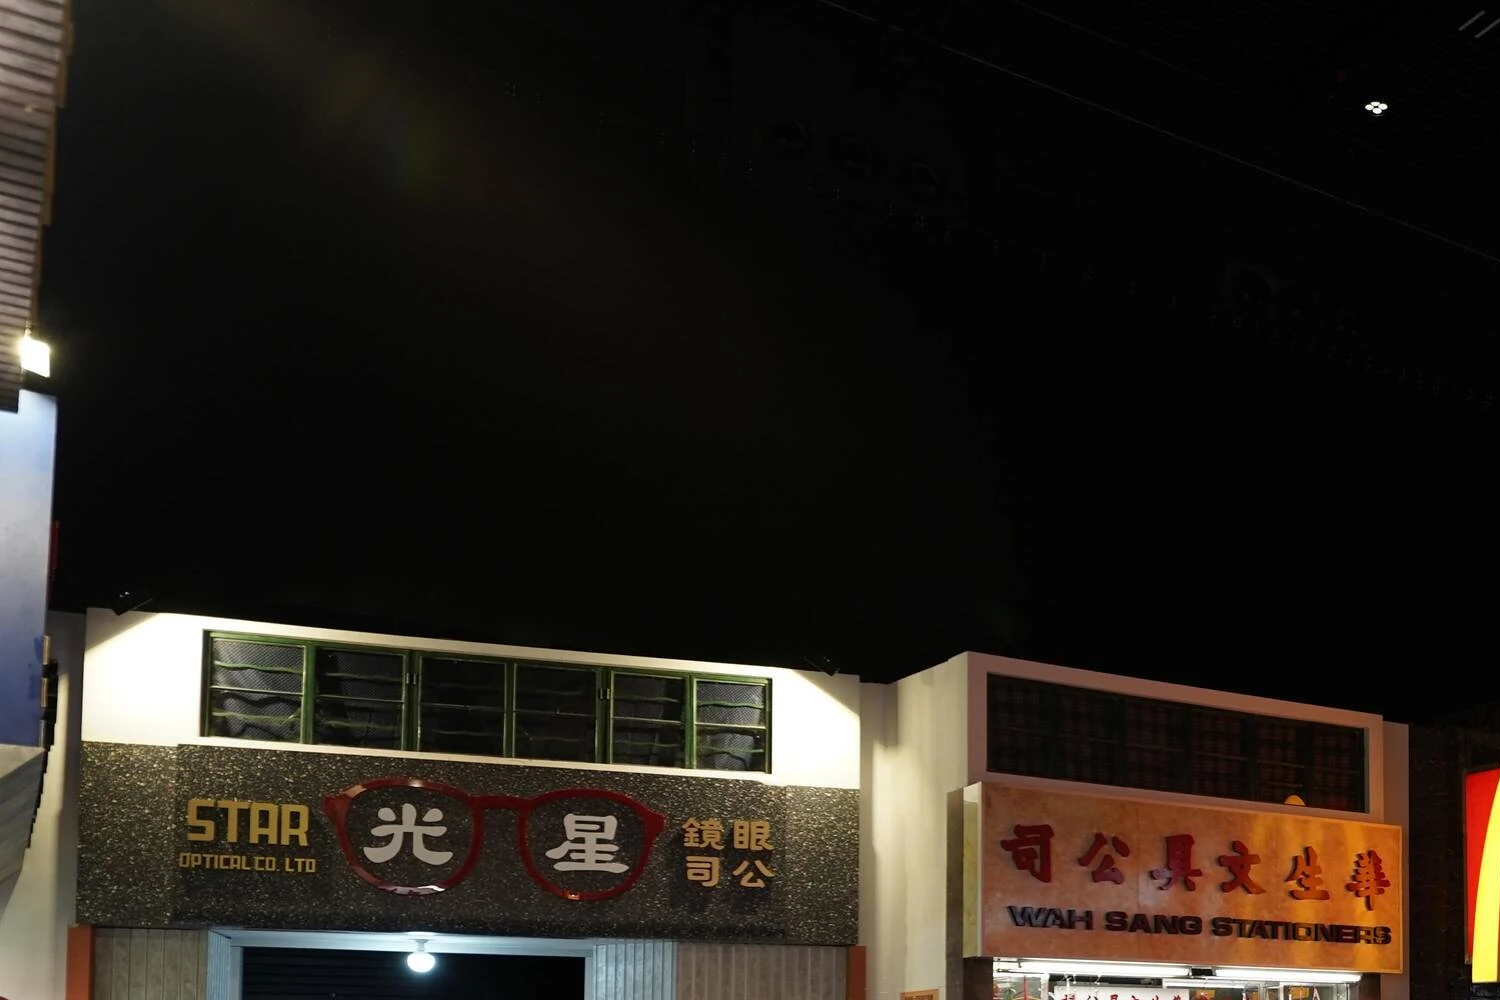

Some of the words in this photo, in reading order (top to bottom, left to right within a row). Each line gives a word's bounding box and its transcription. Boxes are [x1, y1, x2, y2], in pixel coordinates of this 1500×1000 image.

[186, 799, 310, 847] STAR
[178, 853, 250, 871] OPTICAL
[253, 856, 280, 872] CO.
[284, 857, 316, 873] LTD
[1006, 905, 1094, 931] WAH
[1105, 911, 1202, 935] SANG
[1211, 916, 1393, 945] STATIONERS
